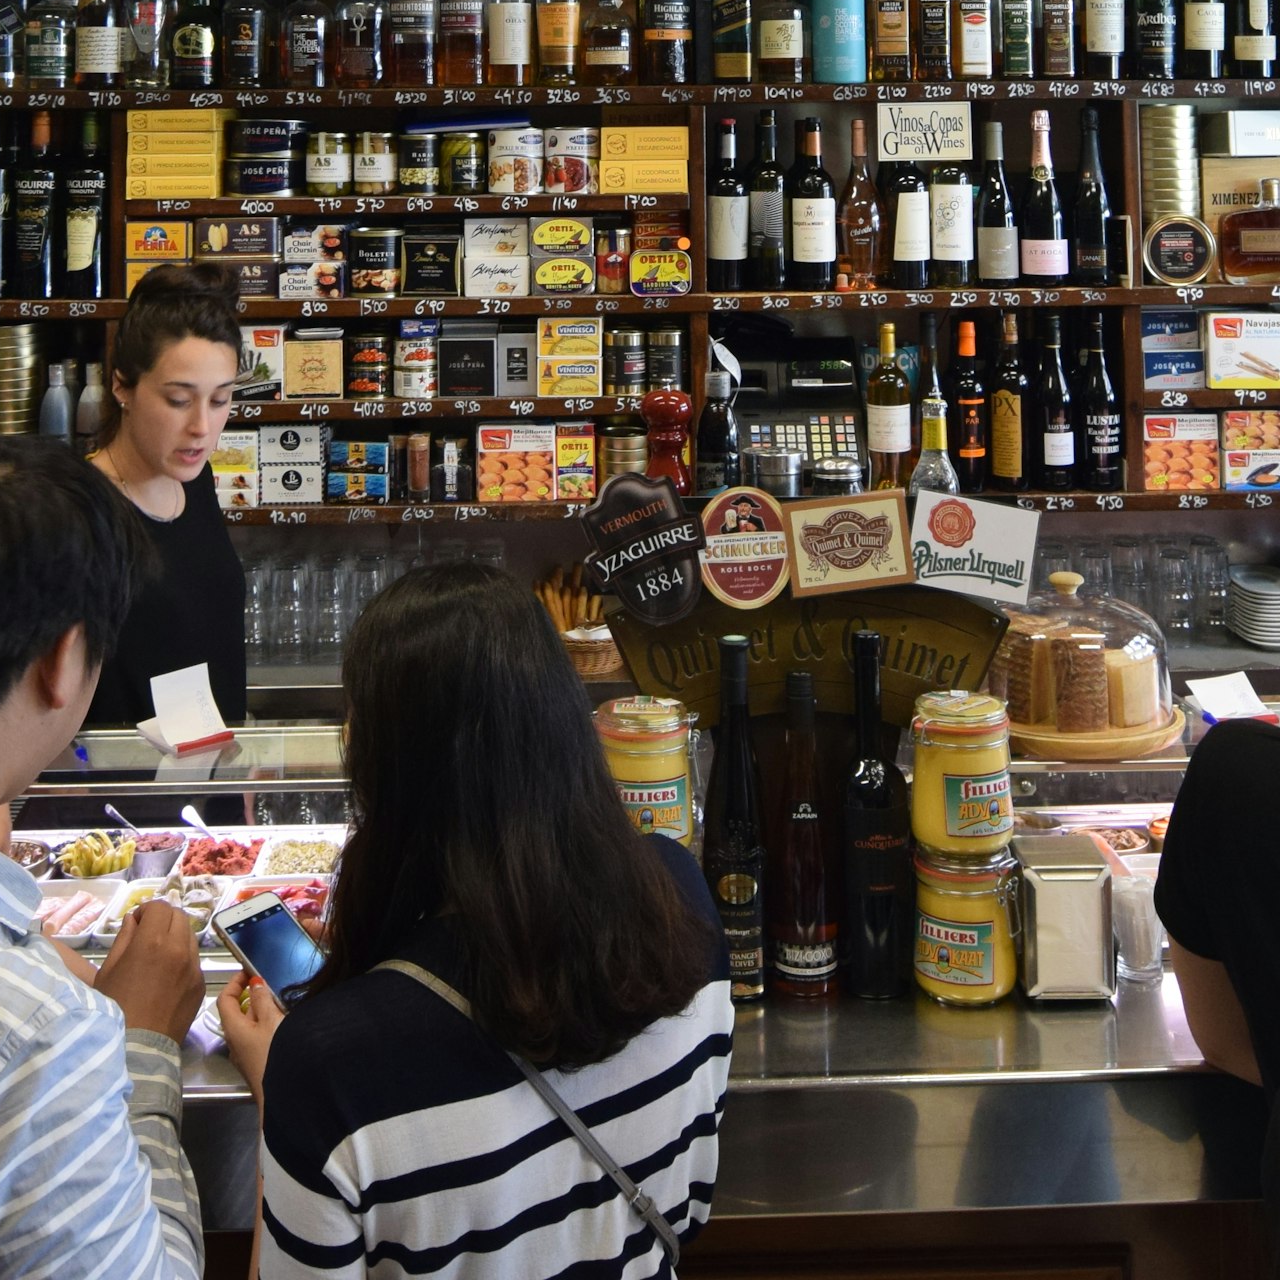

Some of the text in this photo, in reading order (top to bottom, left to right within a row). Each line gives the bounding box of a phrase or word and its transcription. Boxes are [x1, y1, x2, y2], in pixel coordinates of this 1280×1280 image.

[654, 4, 690, 13] HIGHLAND
[664, 12, 684, 20] PARK
[294, 46, 320, 54] SIXTEEN
[714, 86, 752, 100] 199'00
[1092, 82, 1126, 96] 39'90
[444, 90, 476, 105] 31'00
[244, 126, 286, 136] JOSÉ PEÑA
[889, 108, 964, 145] Vinos a Copas
[636, 144, 681, 152] ESCABECHADAS
[884, 129, 965, 156] Glass of Wines
[315, 156, 335, 168] AS
[157, 200, 190, 212] 17'00
[356, 200, 385, 212] 5'70
[241, 223, 260, 235] AS
[549, 225, 576, 233] ORTIZ
[293, 241, 312, 249] Chair
[288, 246, 314, 257] d'Oursin
[359, 251, 394, 262] BOLETUS
[640, 255, 675, 265] ORTIZ
[303, 301, 327, 314] 8'00
[416, 301, 445, 314] 6'90
[478, 300, 510, 313] 3'20
[1246, 319, 1280, 330] Navajas
[557, 326, 596, 336] VENTRESCA
[557, 366, 596, 375] VENTRESCA
[1234, 389, 1267, 403] 9'90
[301, 404, 329, 416] 4'10
[992, 396, 1018, 415] PX
[561, 443, 588, 451] ORTIZ
[1096, 495, 1123, 509] 4'50
[600, 500, 668, 535] VERMOUTH
[826, 513, 865, 527] CERVEZA
[813, 532, 883, 556] Quimet & Quimet
[596, 523, 697, 581] YZAGUIRRE
[704, 541, 785, 560] SCHMUCKER
[829, 551, 870, 568] ESPECIAL
[913, 541, 1025, 584] Pilsner Urquell
[636, 568, 684, 601] 1884
[792, 812, 818, 820] ZAPIAIN
